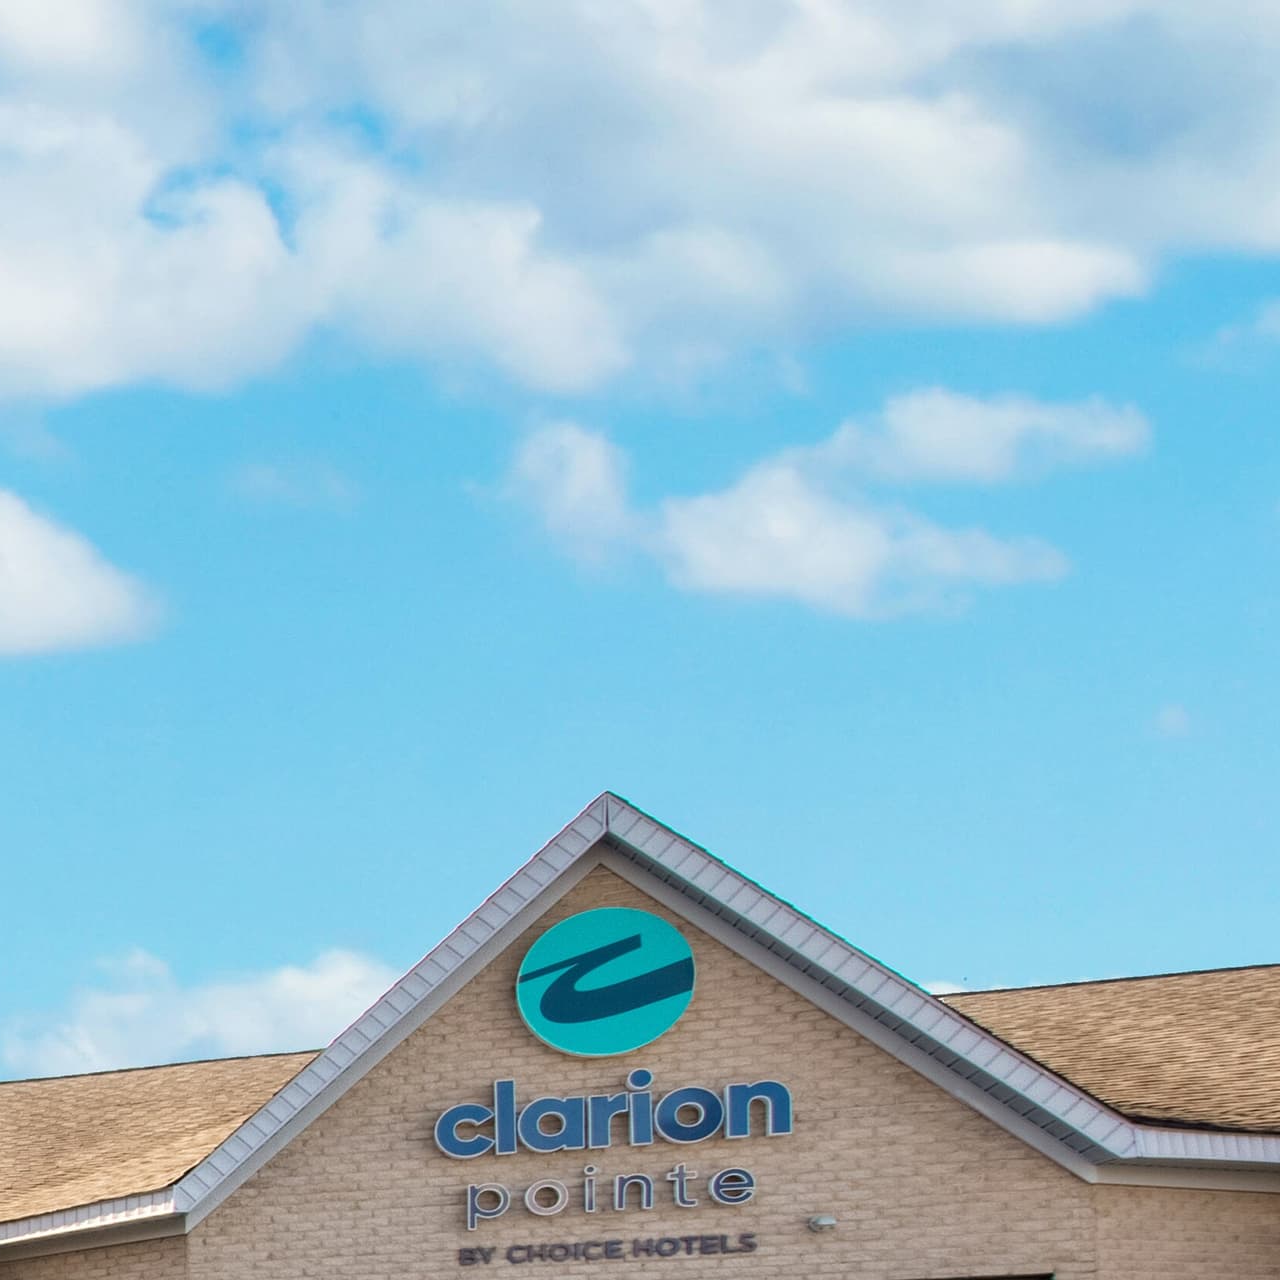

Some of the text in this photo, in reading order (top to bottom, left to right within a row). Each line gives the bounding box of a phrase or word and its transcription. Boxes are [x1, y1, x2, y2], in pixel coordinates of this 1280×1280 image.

[434, 1068, 793, 1159] clarion
[467, 1162, 757, 1230] pointe
[458, 1233, 758, 1267] BY CHOICE HOTELS
